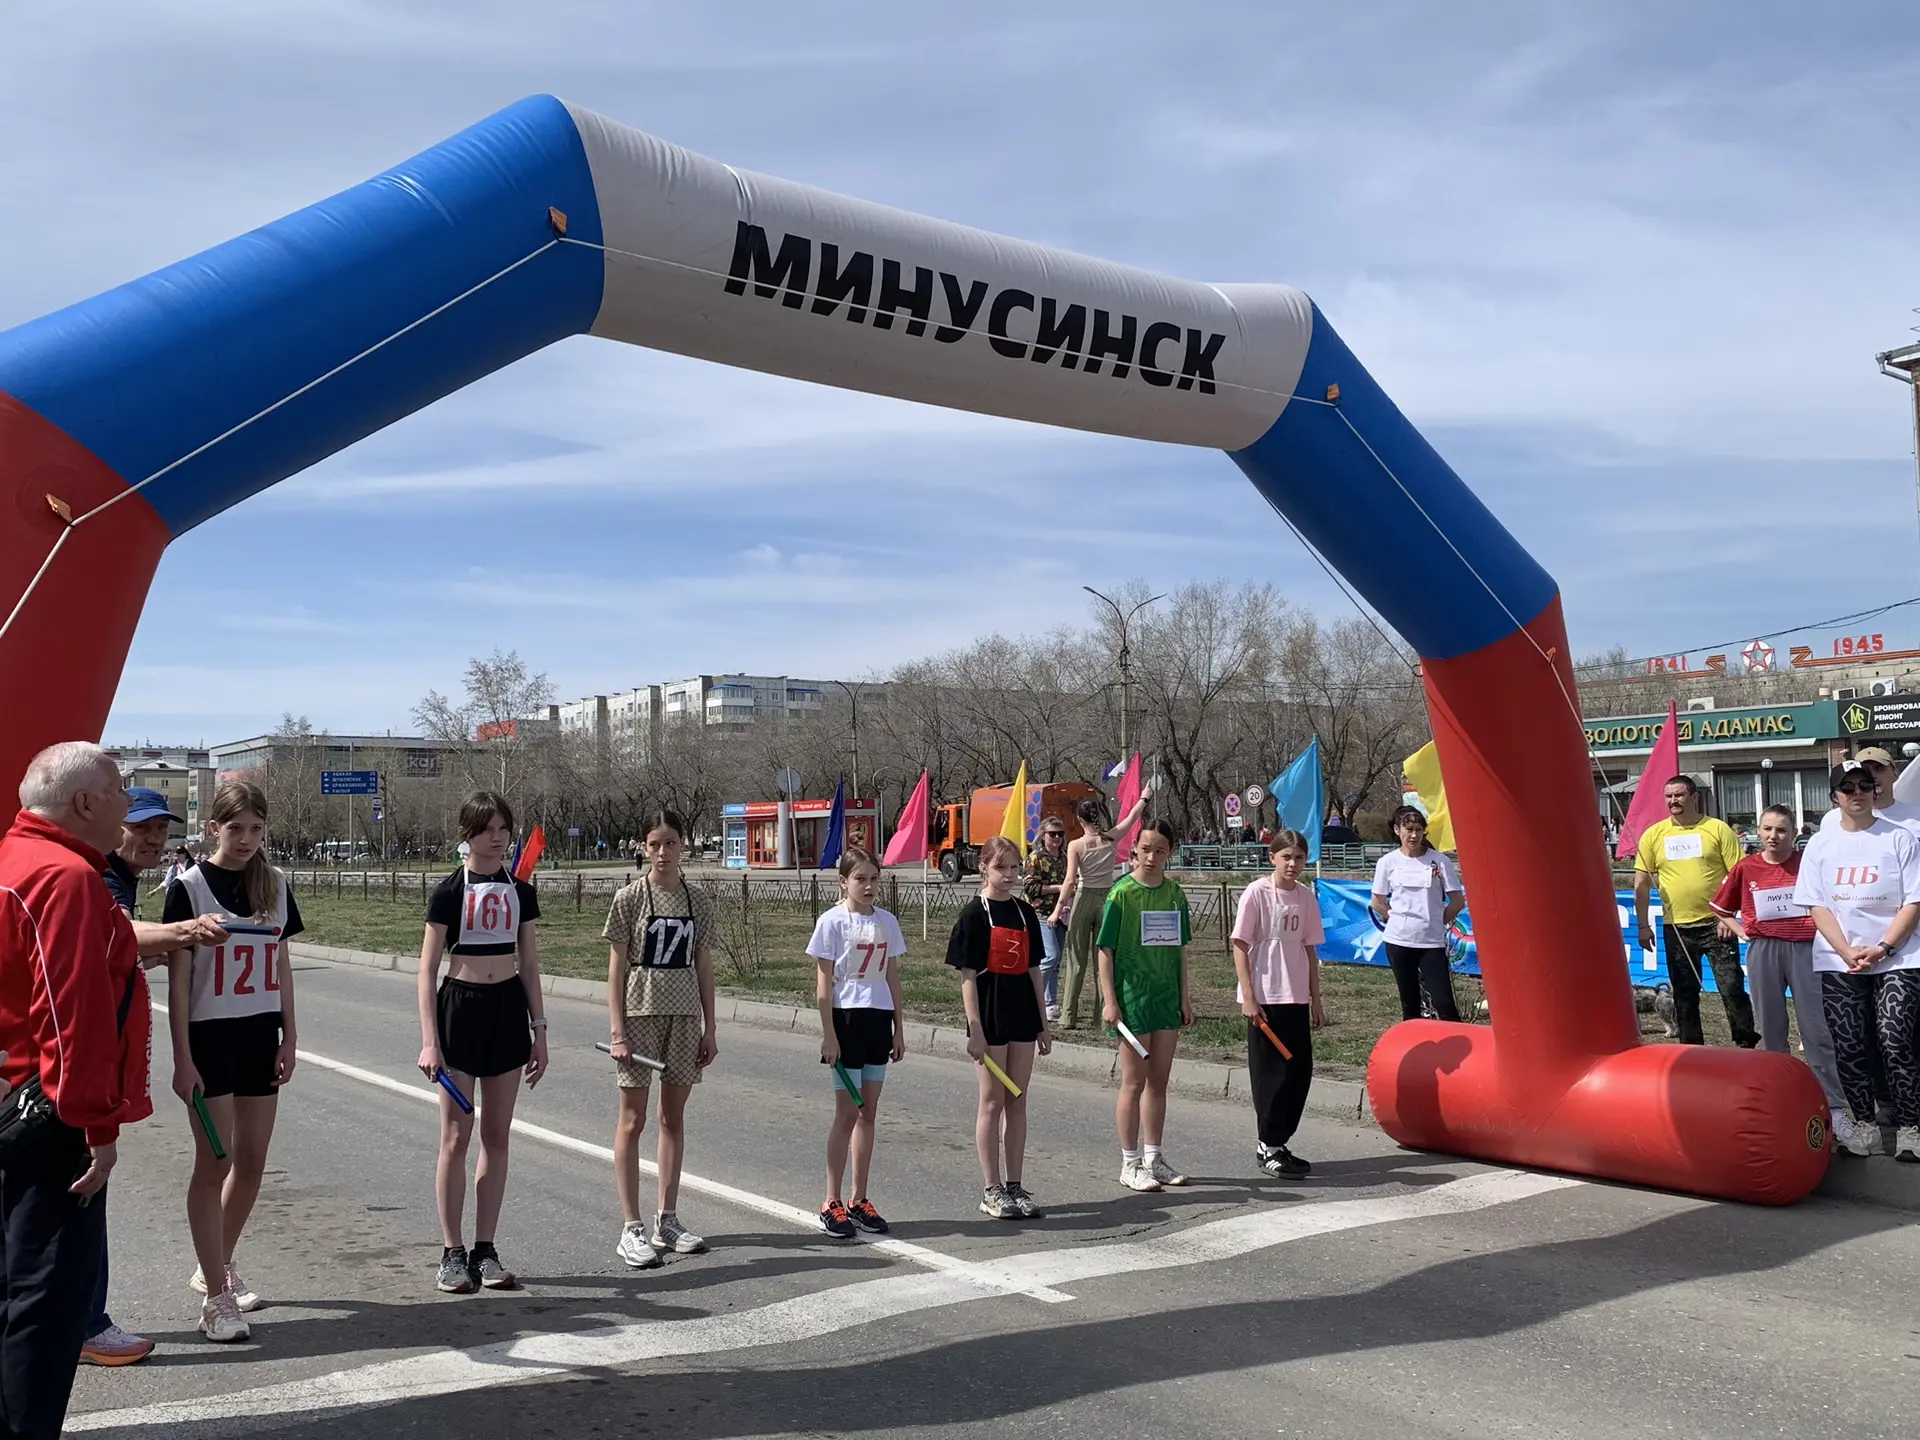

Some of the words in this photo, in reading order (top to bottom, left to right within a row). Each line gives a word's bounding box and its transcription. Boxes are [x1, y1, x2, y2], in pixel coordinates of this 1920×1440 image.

[724, 221, 1226, 394] МИНУСИНСК
[1834, 634, 1884, 656] 1945
[1647, 655, 1687, 672] 1941
[1874, 703, 1920, 711] БРОНИРОВА
[1700, 714, 1794, 738] АДАМАС
[1875, 721, 1920, 730] АКСЕССУАР
[1250, 791, 1260, 801] 20
[1834, 865, 1879, 888] ЦБ
[466, 892, 511, 930] 161
[1283, 914, 1299, 931] 10
[648, 918, 694, 965] 171
[856, 941, 887, 978] 77
[1003, 938, 1021, 969] 3
